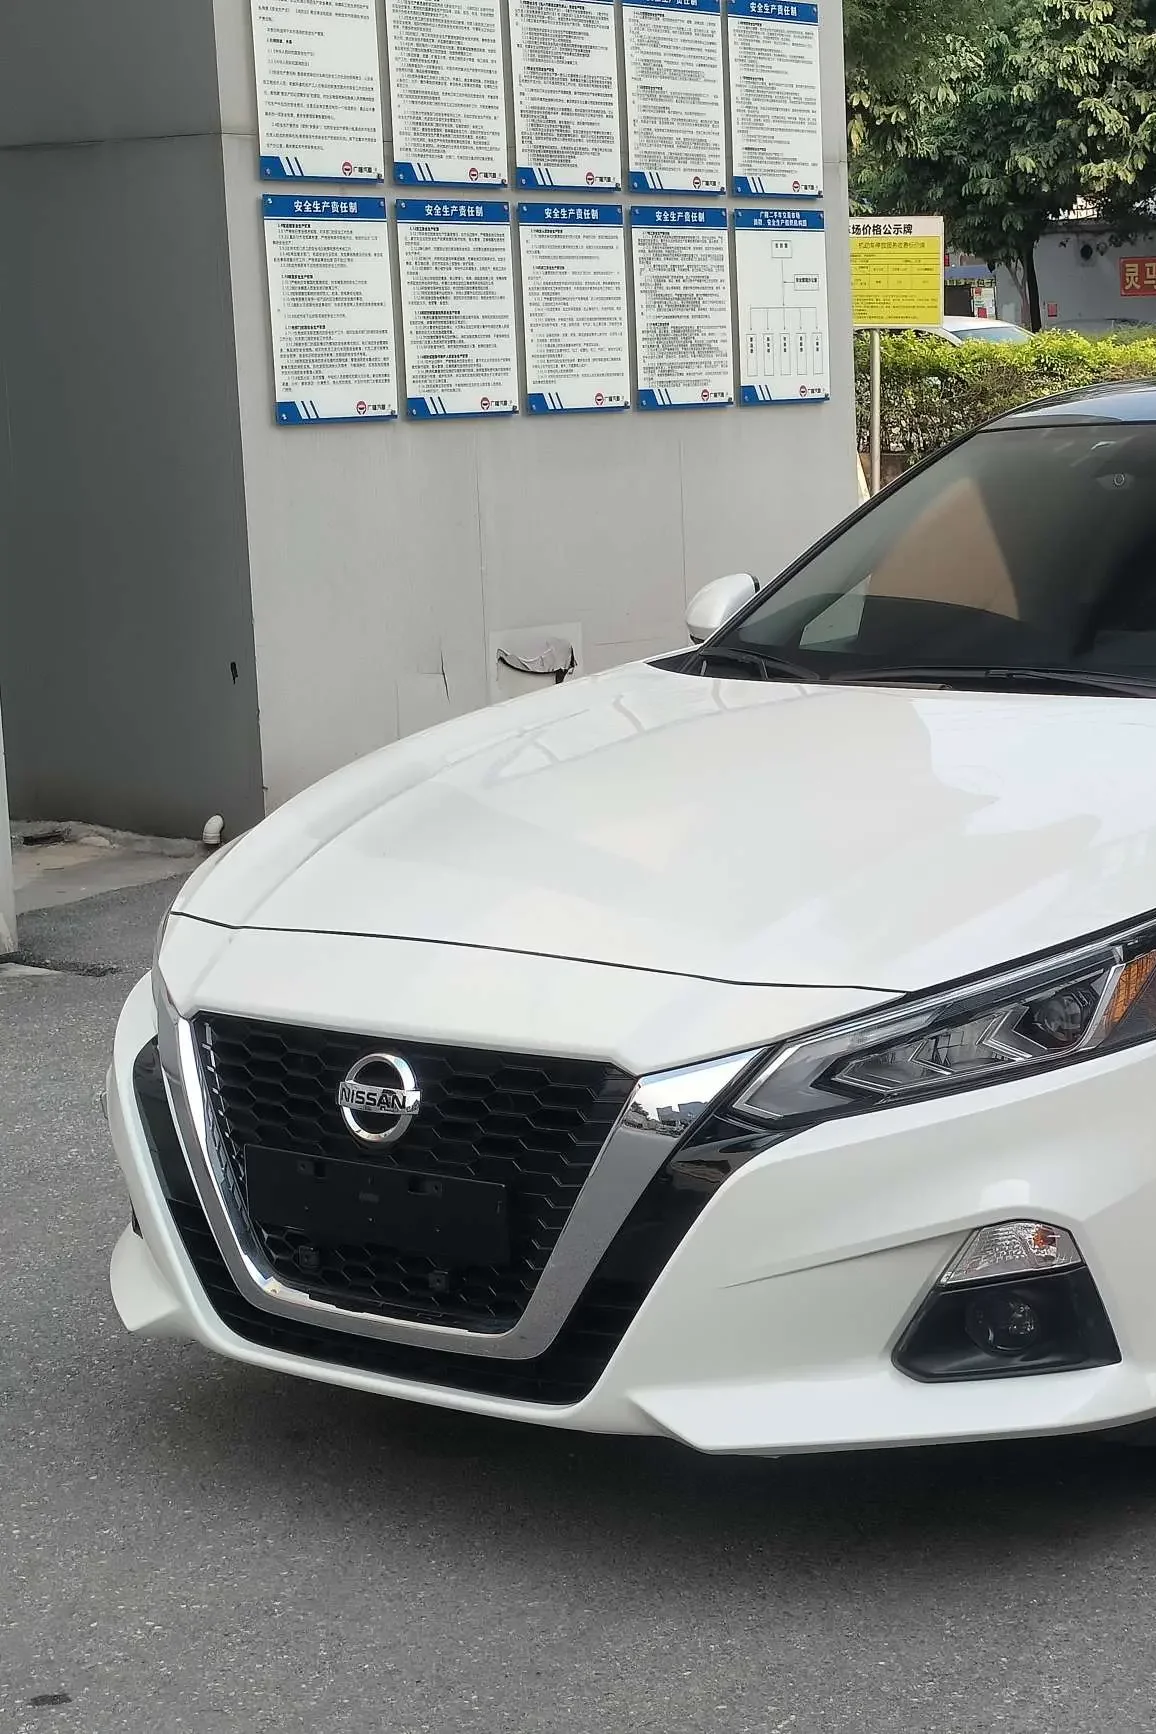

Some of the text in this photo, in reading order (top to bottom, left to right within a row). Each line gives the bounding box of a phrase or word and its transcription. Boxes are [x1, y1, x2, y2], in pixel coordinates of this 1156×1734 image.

[749, 2, 798, 17] 安全生产责任制
[294, 200, 358, 214] 安全生产责任制
[425, 204, 484, 218] 安全生产责任制
[544, 207, 599, 221] 安全生产责任制
[655, 211, 705, 223] 安全生产责任制
[849, 223, 913, 235] 场价格公示牌
[341, 1088, 407, 1110] NISSAN
